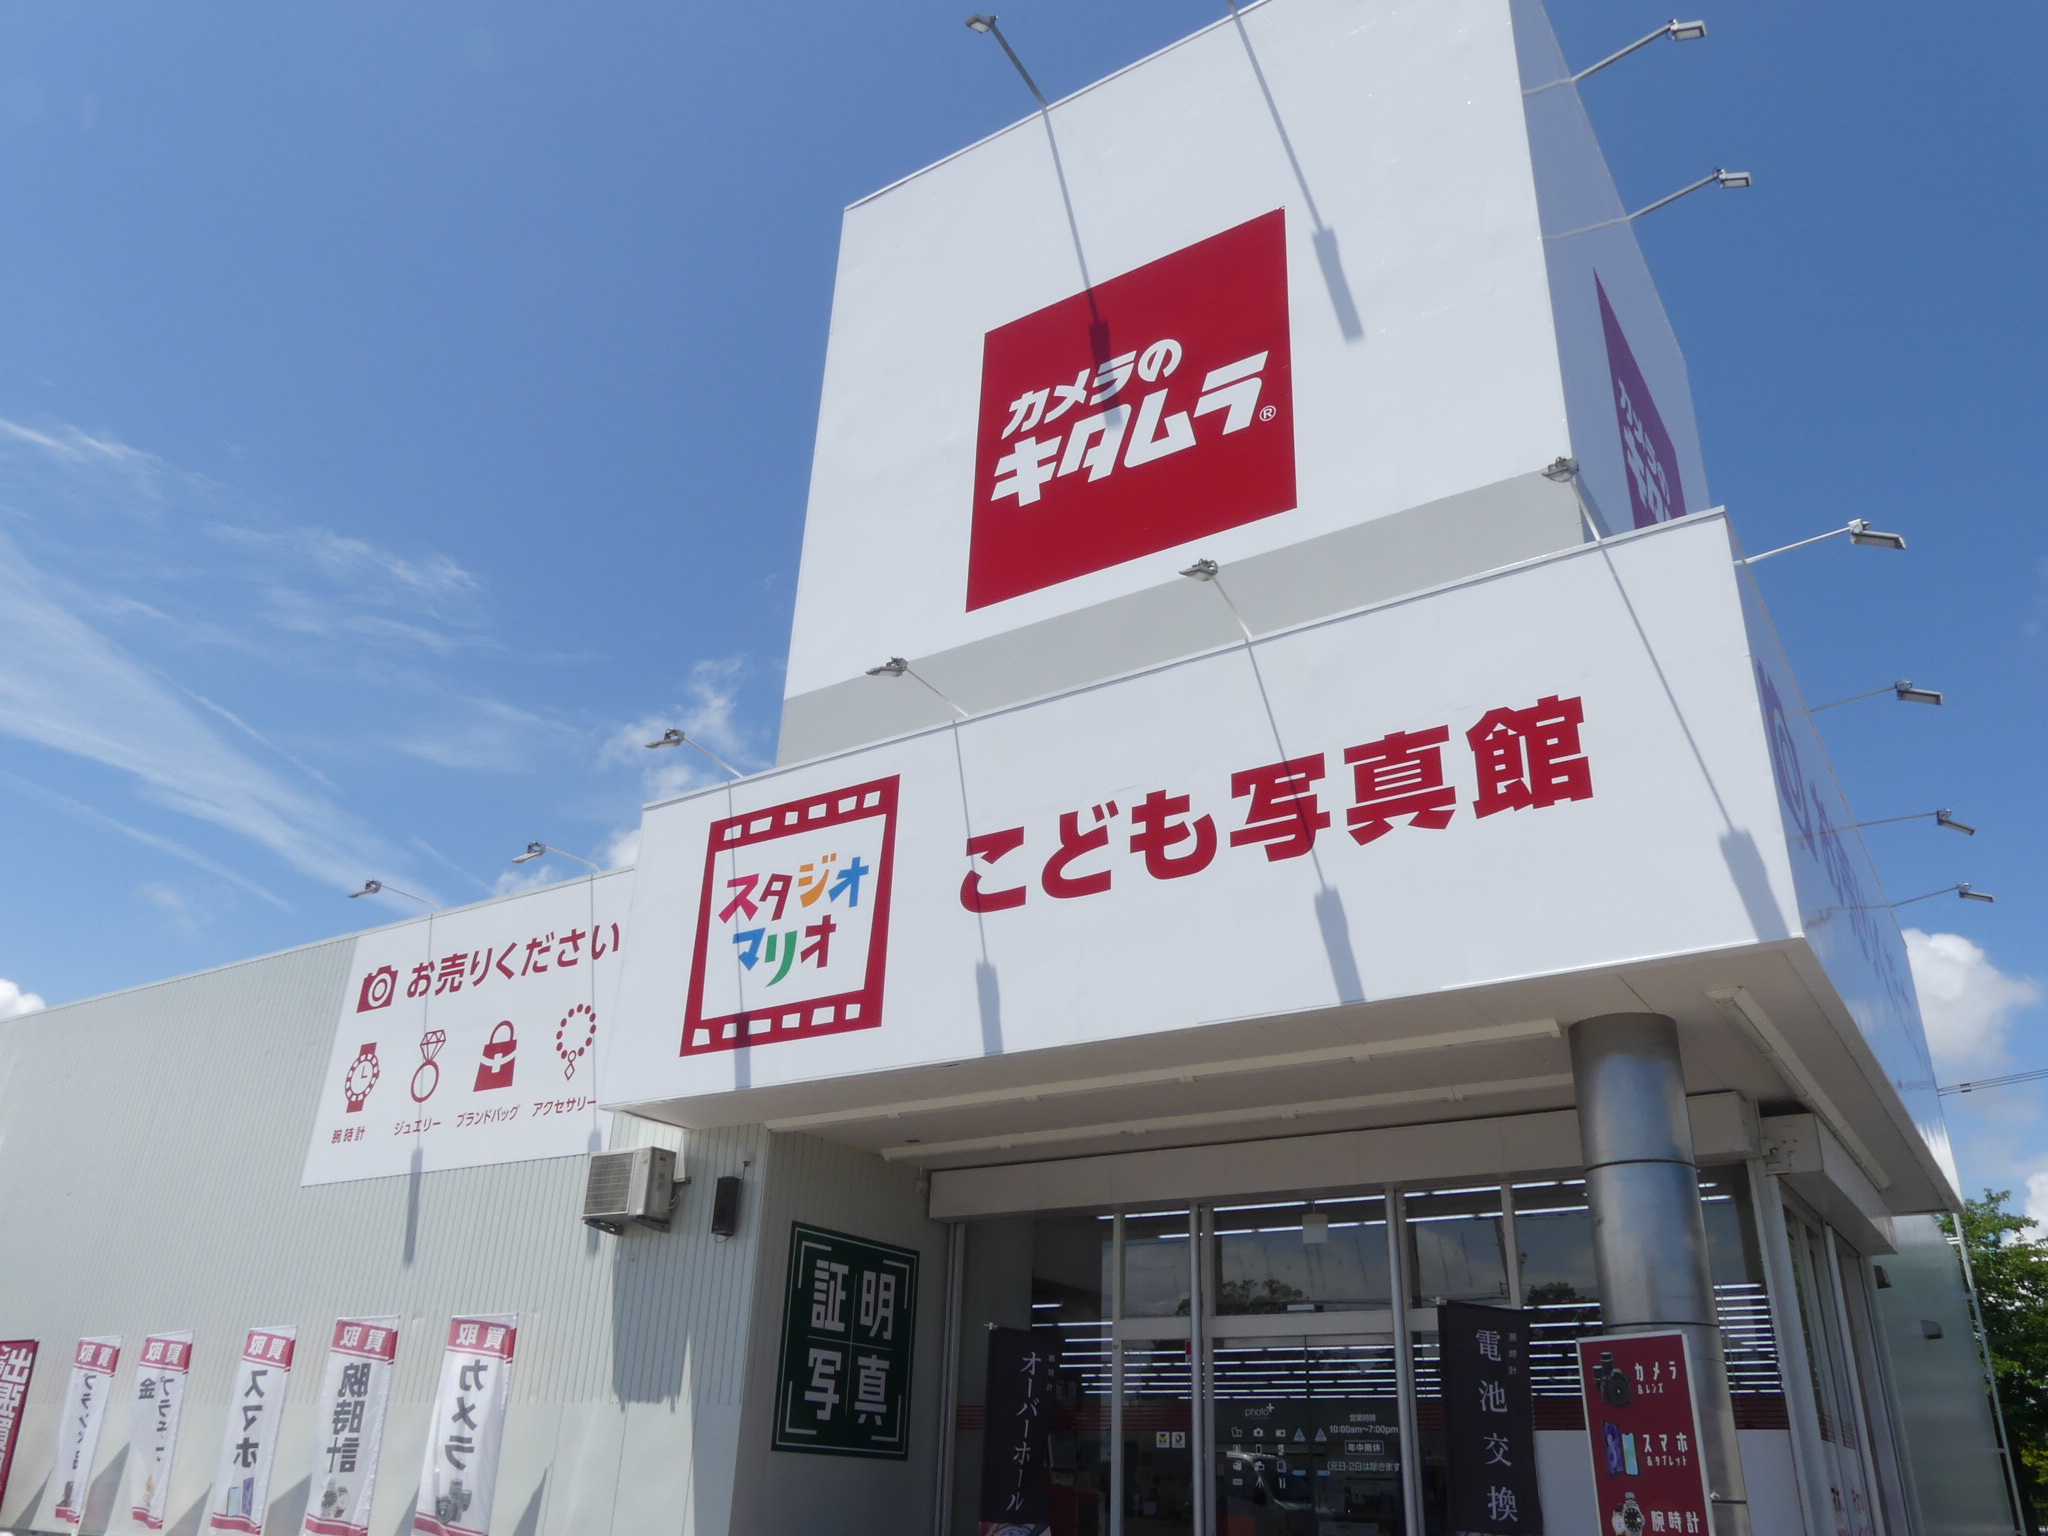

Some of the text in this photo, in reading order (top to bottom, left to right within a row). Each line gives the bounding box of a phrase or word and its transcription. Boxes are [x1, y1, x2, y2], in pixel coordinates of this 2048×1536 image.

[1001, 338, 1183, 440] カメラの
[990, 351, 1269, 507] キタムラ
[960, 694, 1594, 914] こども写真館
[718, 852, 869, 924] スタジオ
[406, 922, 620, 998] お売りください
[732, 914, 837, 988] マリオ
[330, 1126, 365, 1145] 腕時計
[393, 1118, 441, 1136] ジュエリー
[455, 1104, 521, 1128] ブランドバッグ
[531, 1096, 597, 1117] アクセサリー
[811, 1259, 896, 1341] 証明
[804, 1347, 890, 1426] 写真
[1634, 1360, 1677, 1382] カメラ
[1006, 1351, 1042, 1512] オーバーホール
[1476, 1329, 1518, 1522] 電池交換
[1643, 1432, 1688, 1453] スマホ
[1650, 1510, 1699, 1534] 腕時計
